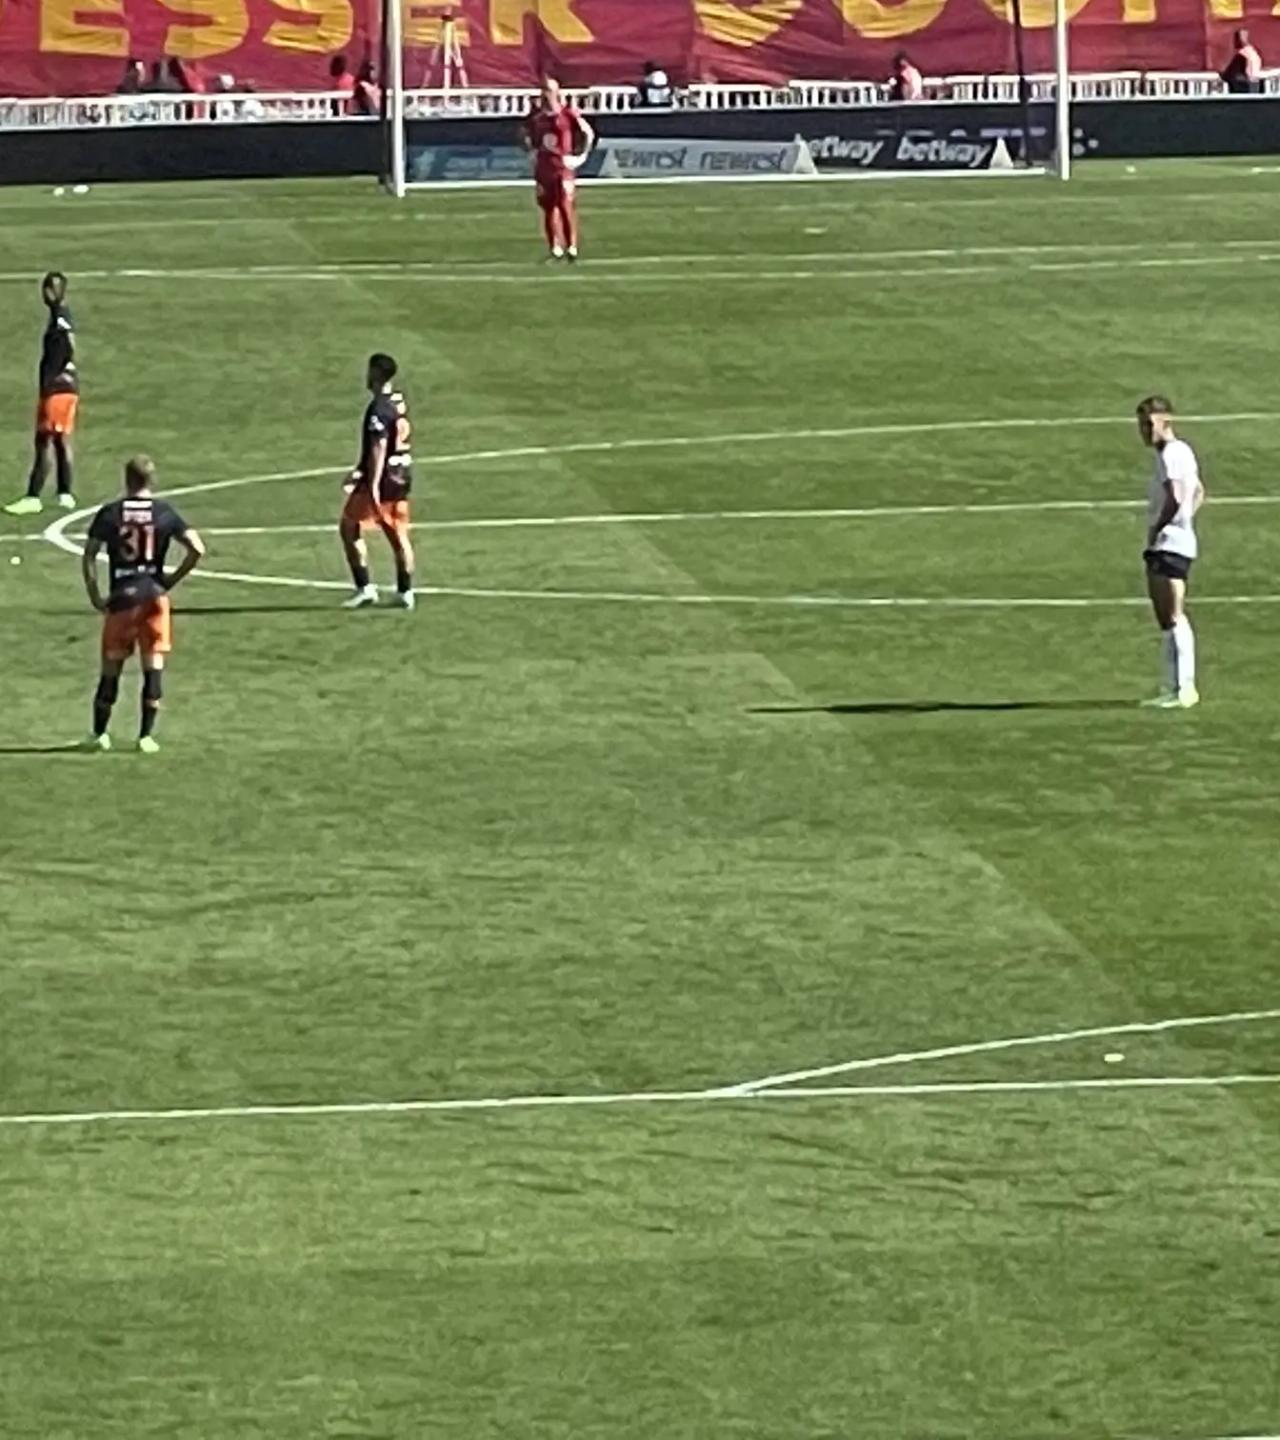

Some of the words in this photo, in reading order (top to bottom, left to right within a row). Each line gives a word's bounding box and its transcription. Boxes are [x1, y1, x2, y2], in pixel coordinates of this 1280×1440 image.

[807, 133, 884, 165] etway
[895, 136, 992, 168] betway
[118, 524, 156, 562] 31
